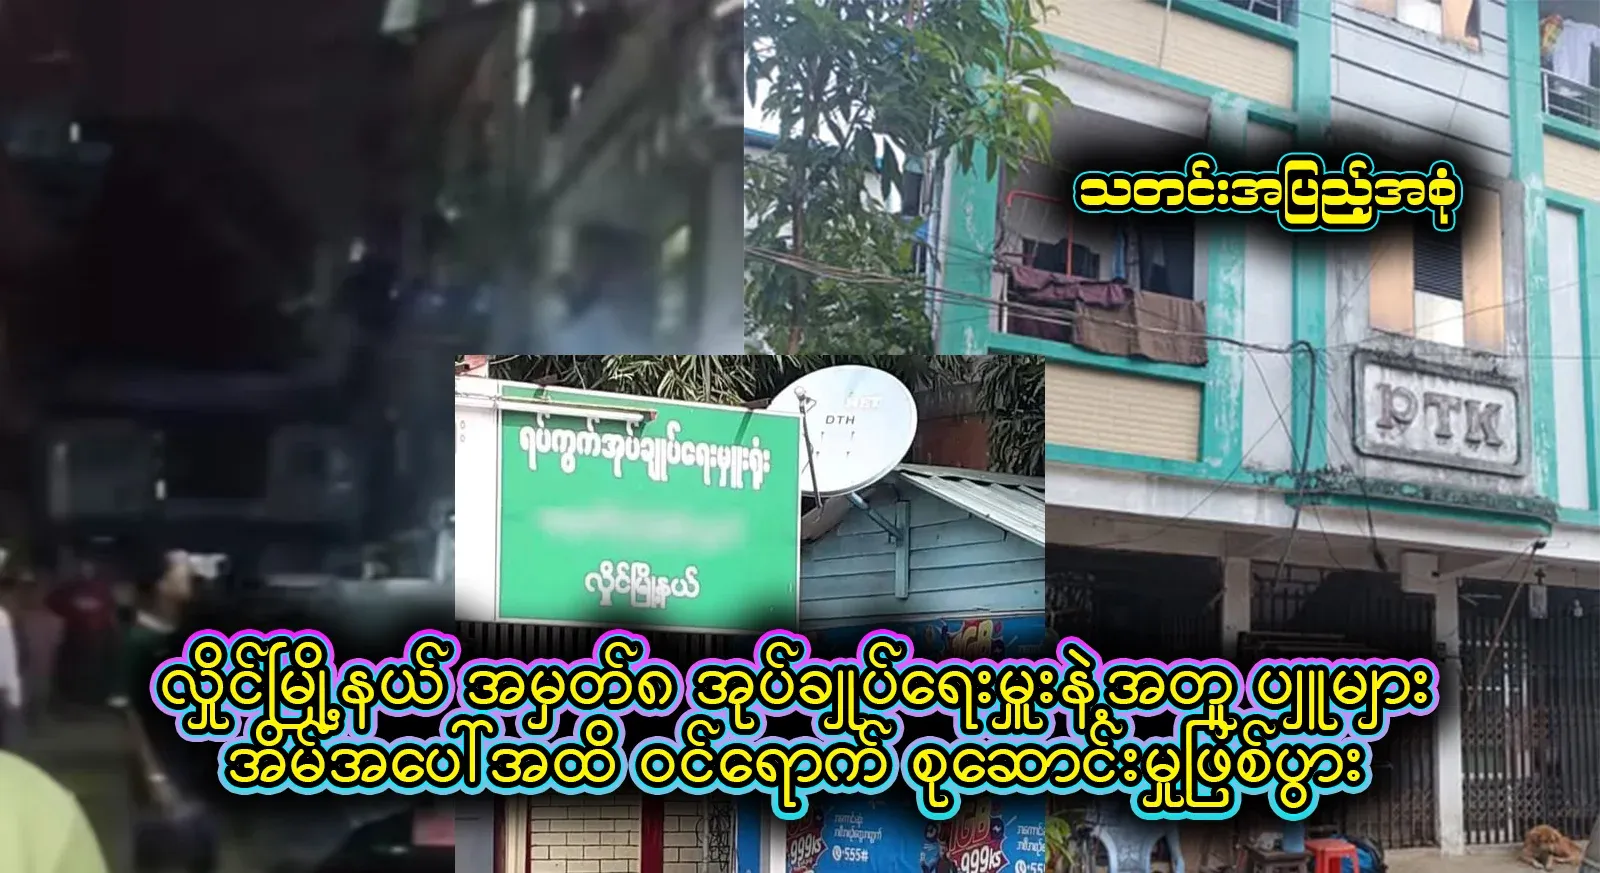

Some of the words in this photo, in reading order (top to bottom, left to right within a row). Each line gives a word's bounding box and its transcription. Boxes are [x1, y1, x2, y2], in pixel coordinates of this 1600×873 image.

[825, 414, 855, 425] DTH
[584, 559, 700, 609] လှိုင်မြို့နယ်
